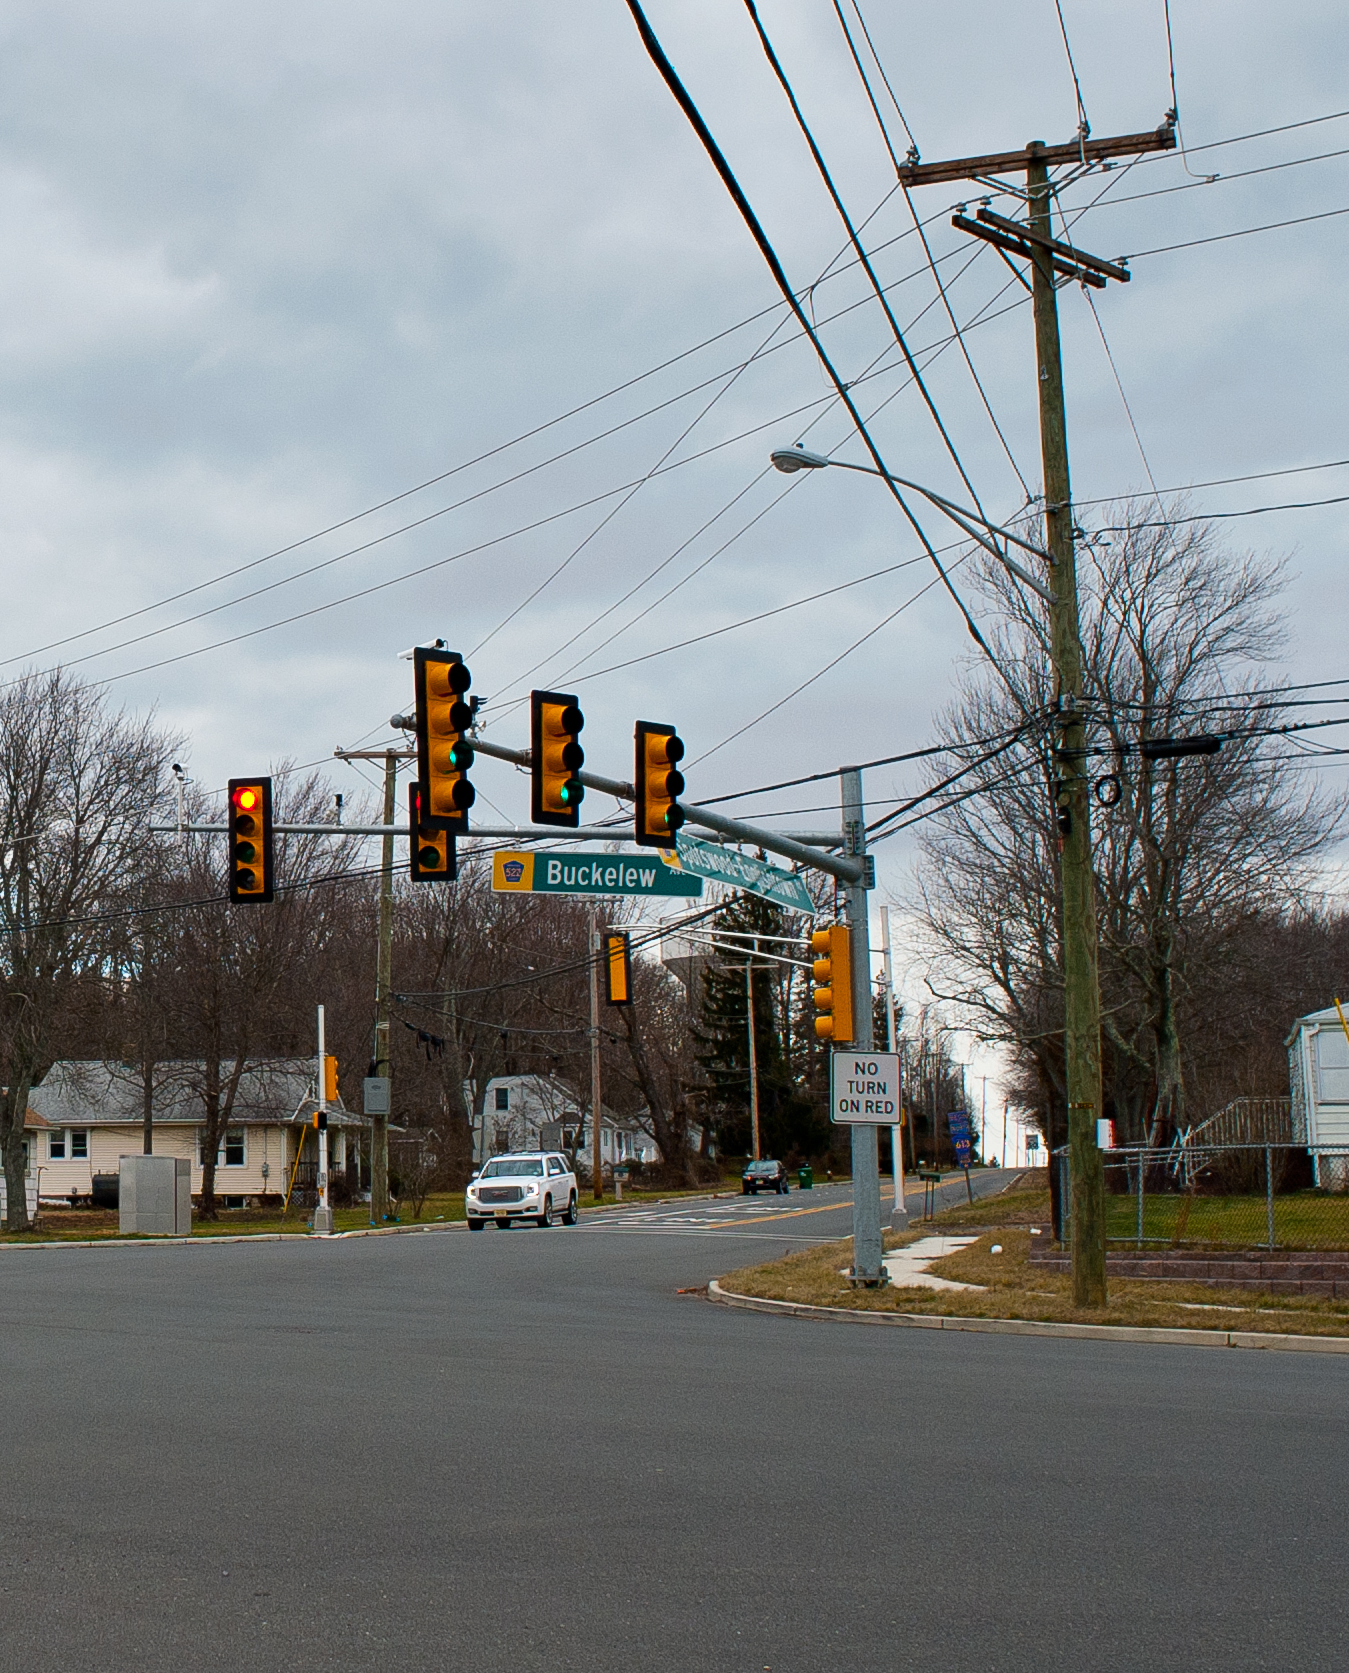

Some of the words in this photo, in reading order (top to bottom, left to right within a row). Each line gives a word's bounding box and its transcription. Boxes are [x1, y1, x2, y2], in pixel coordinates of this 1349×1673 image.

[547, 860, 656, 888] Buckelew
[854, 1061, 879, 1076] NO
[847, 1080, 887, 1095] TURN
[839, 1099, 860, 1113] ON
[865, 1100, 894, 1114] RED
